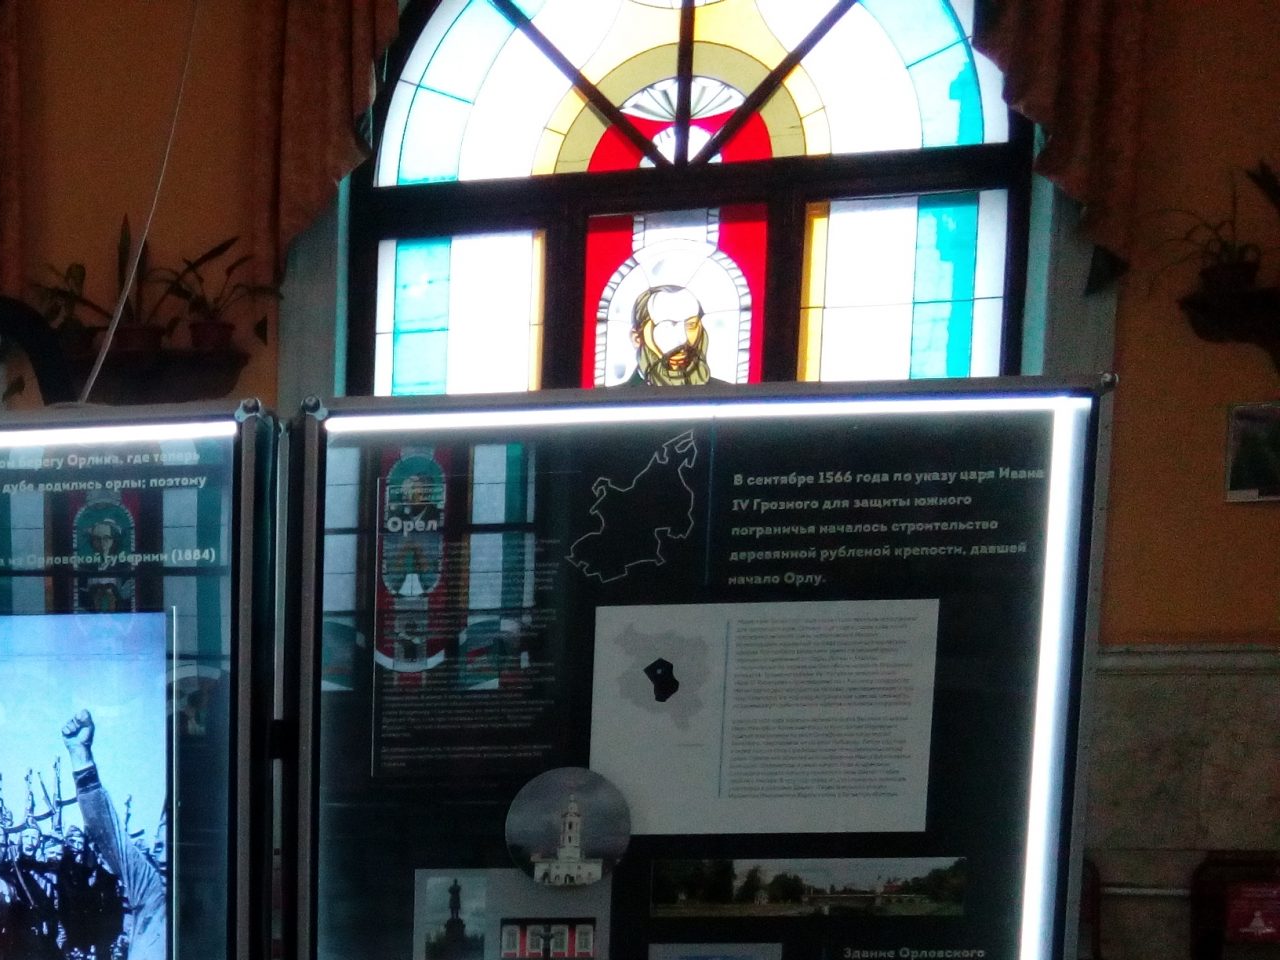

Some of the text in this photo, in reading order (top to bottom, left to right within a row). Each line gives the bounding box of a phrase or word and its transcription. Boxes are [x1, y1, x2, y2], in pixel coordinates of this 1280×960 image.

[19, 454, 63, 471] берегу
[67, 453, 124, 470] Орлика,
[127, 453, 150, 465] где
[152, 452, 200, 466] теперь
[2, 479, 34, 496] дубе
[38, 479, 102, 492] водились
[149, 476, 208, 490] поэтому
[746, 472, 815, 488] сентябре
[817, 471, 853, 484] 1566
[856, 472, 889, 484] года
[914, 471, 957, 485] указу
[959, 470, 995, 484] царя
[998, 467, 1045, 480] Ивана
[753, 498, 819, 514] Грозного
[822, 498, 849, 510] для
[853, 497, 910, 509] защиты
[914, 495, 973, 507] южного
[730, 520, 999, 539] пограничья началось строительство
[25, 551, 100, 569] Орловской
[104, 550, 168, 568] губернии
[729, 540, 1027, 564] деревянной рубленой крепости, давшей
[728, 571, 826, 587] начало Орлу.
[843, 947, 895, 960] Здание
